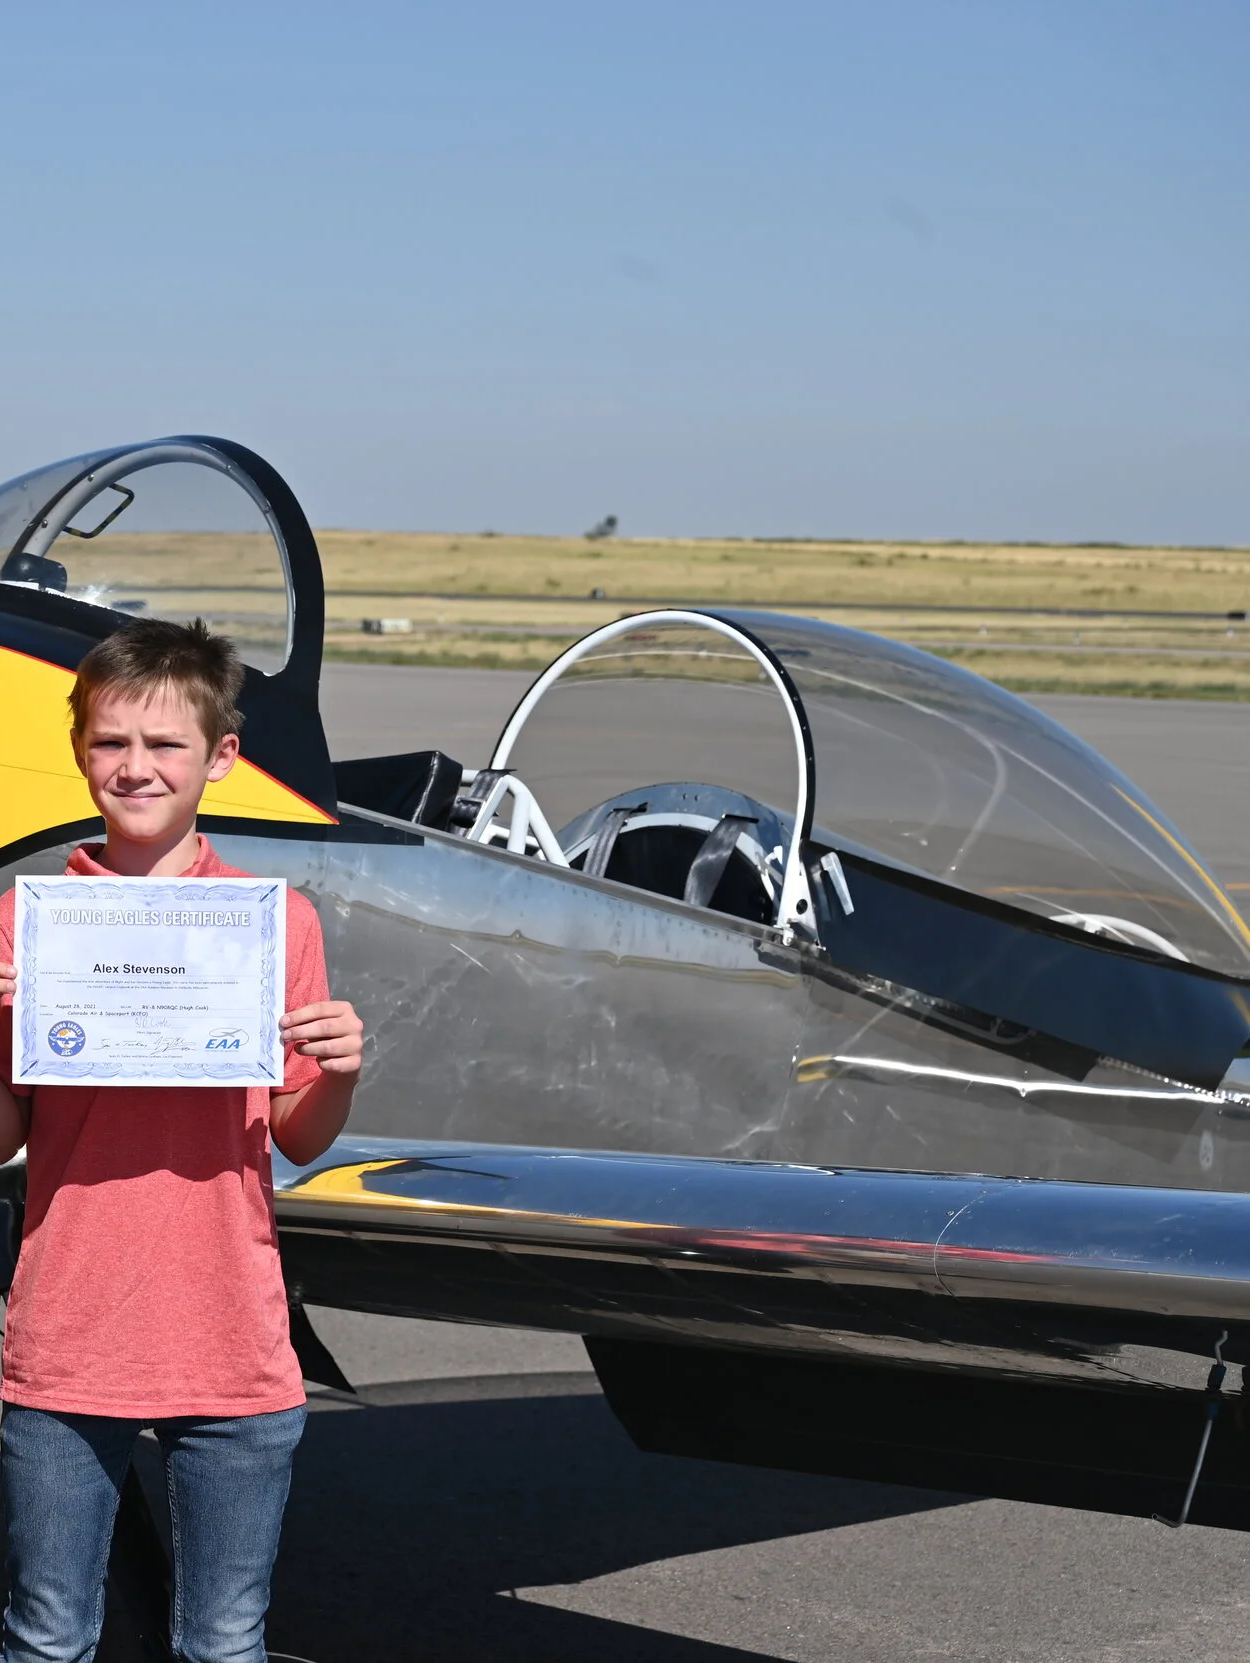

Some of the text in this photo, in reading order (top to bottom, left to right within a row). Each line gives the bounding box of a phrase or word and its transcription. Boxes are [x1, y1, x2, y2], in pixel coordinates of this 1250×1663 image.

[50, 908, 250, 927] YOUNG EAGLES CERTIFICATE
[93, 963, 186, 975] Alex Stevenson
[205, 1038, 241, 1049] EAA
